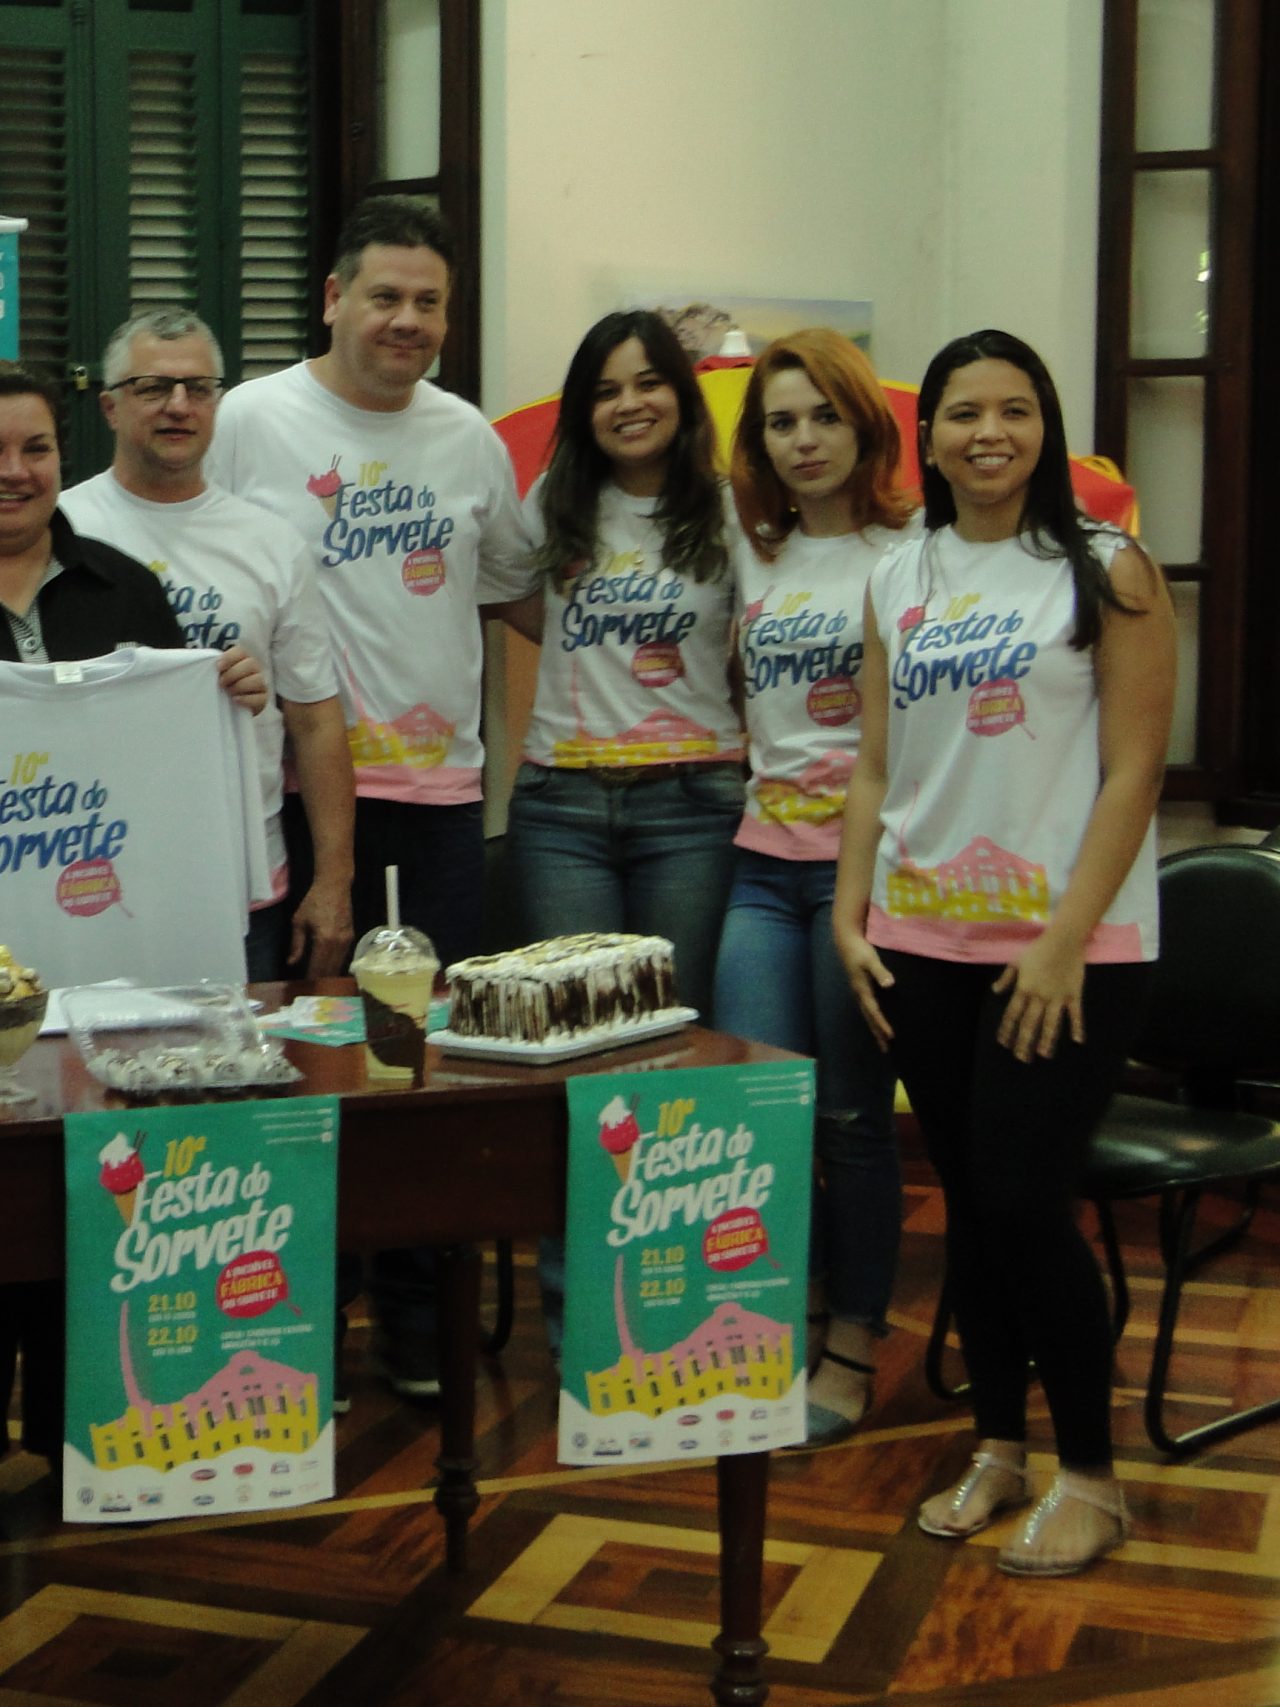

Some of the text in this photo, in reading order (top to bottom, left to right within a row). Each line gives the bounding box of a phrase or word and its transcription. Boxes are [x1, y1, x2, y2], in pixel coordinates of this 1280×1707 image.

[334, 480, 436, 521] Festa do
[321, 510, 455, 568] Sorvete
[568, 571, 659, 606] Festa
[562, 602, 698, 652] Sorvete
[743, 609, 827, 648] Festa
[900, 612, 998, 656] Festa
[893, 637, 1038, 710] Sorvete
[81, 779, 108, 811] do
[629, 1123, 754, 1183] Festa do
[131, 1161, 271, 1227] Festa do
[606, 1158, 775, 1247] Sorvete
[110, 1199, 295, 1294] Sorvete
